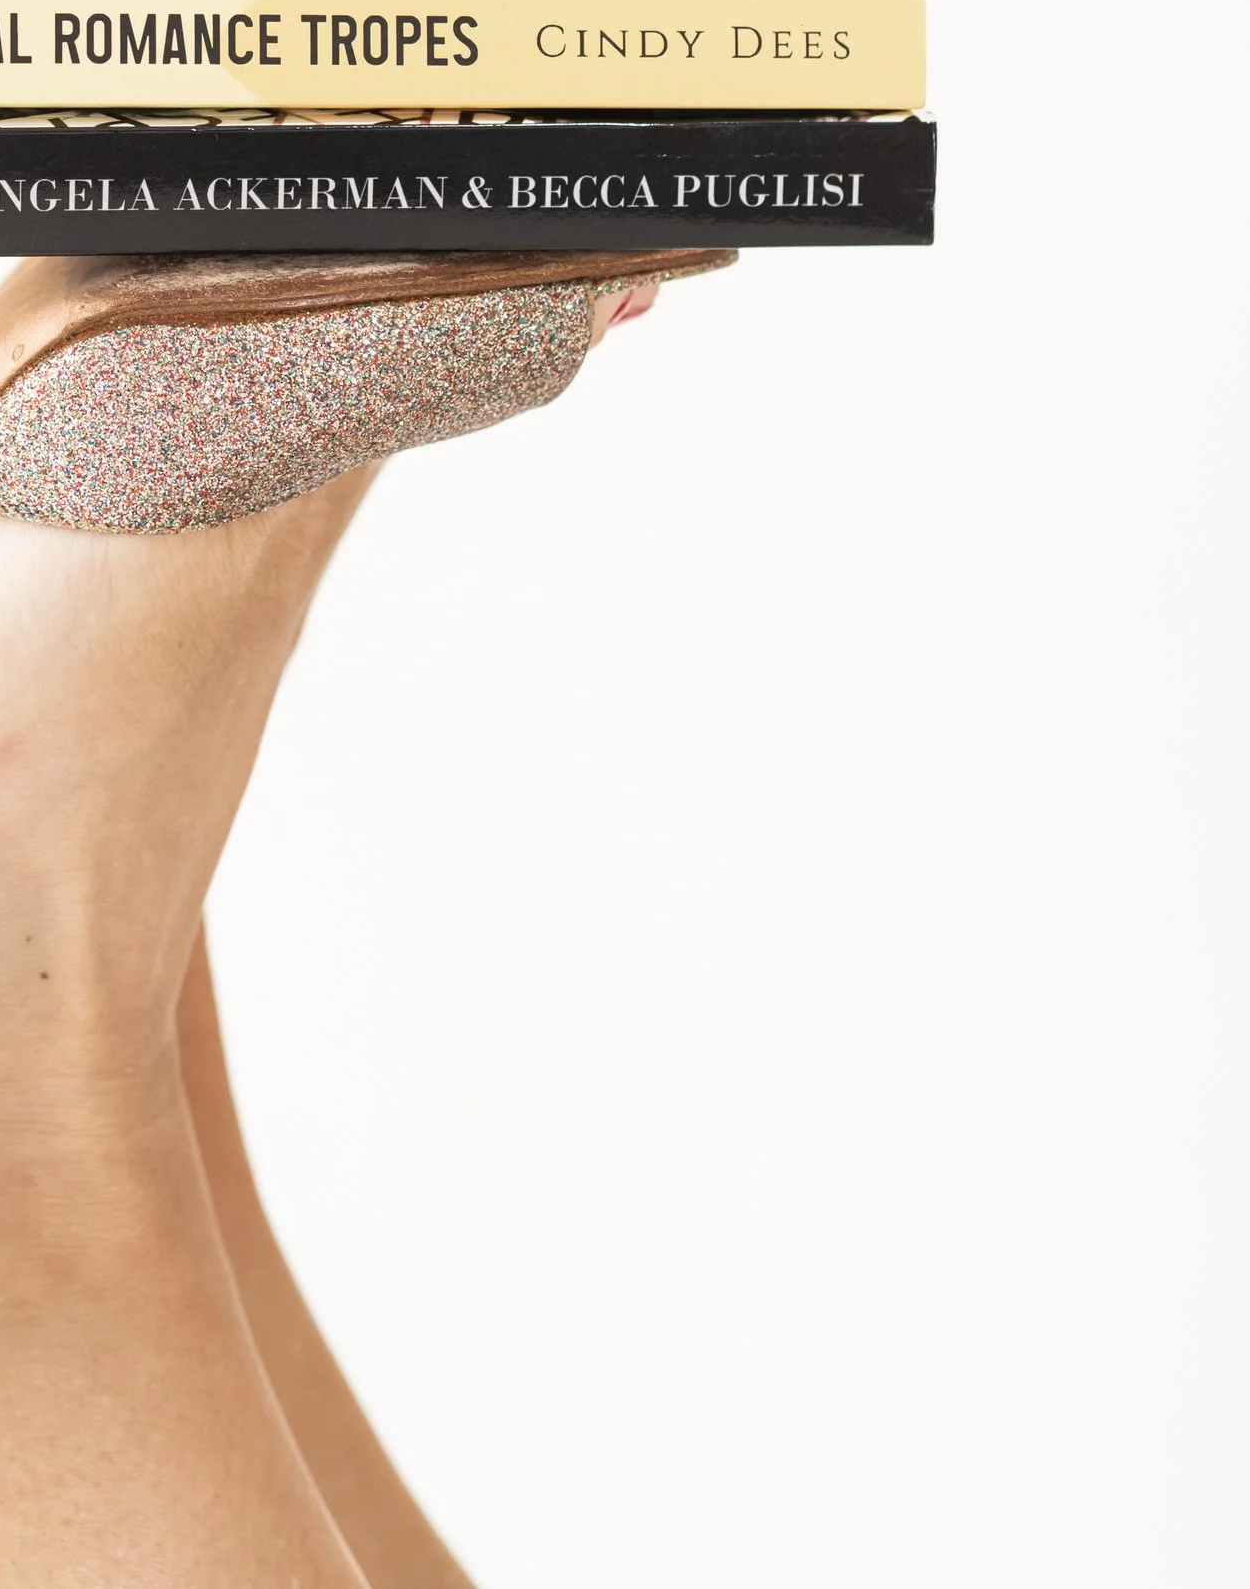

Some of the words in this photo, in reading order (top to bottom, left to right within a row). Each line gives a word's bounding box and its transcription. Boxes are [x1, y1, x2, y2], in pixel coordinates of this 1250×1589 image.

[54, 12, 282, 66] ROMANCE
[300, 14, 479, 67] TROPES
[173, 176, 448, 211] ACKERMAN
[461, 176, 493, 209] &
[507, 174, 659, 209] BECCA
[673, 173, 864, 208] PUGLISI
